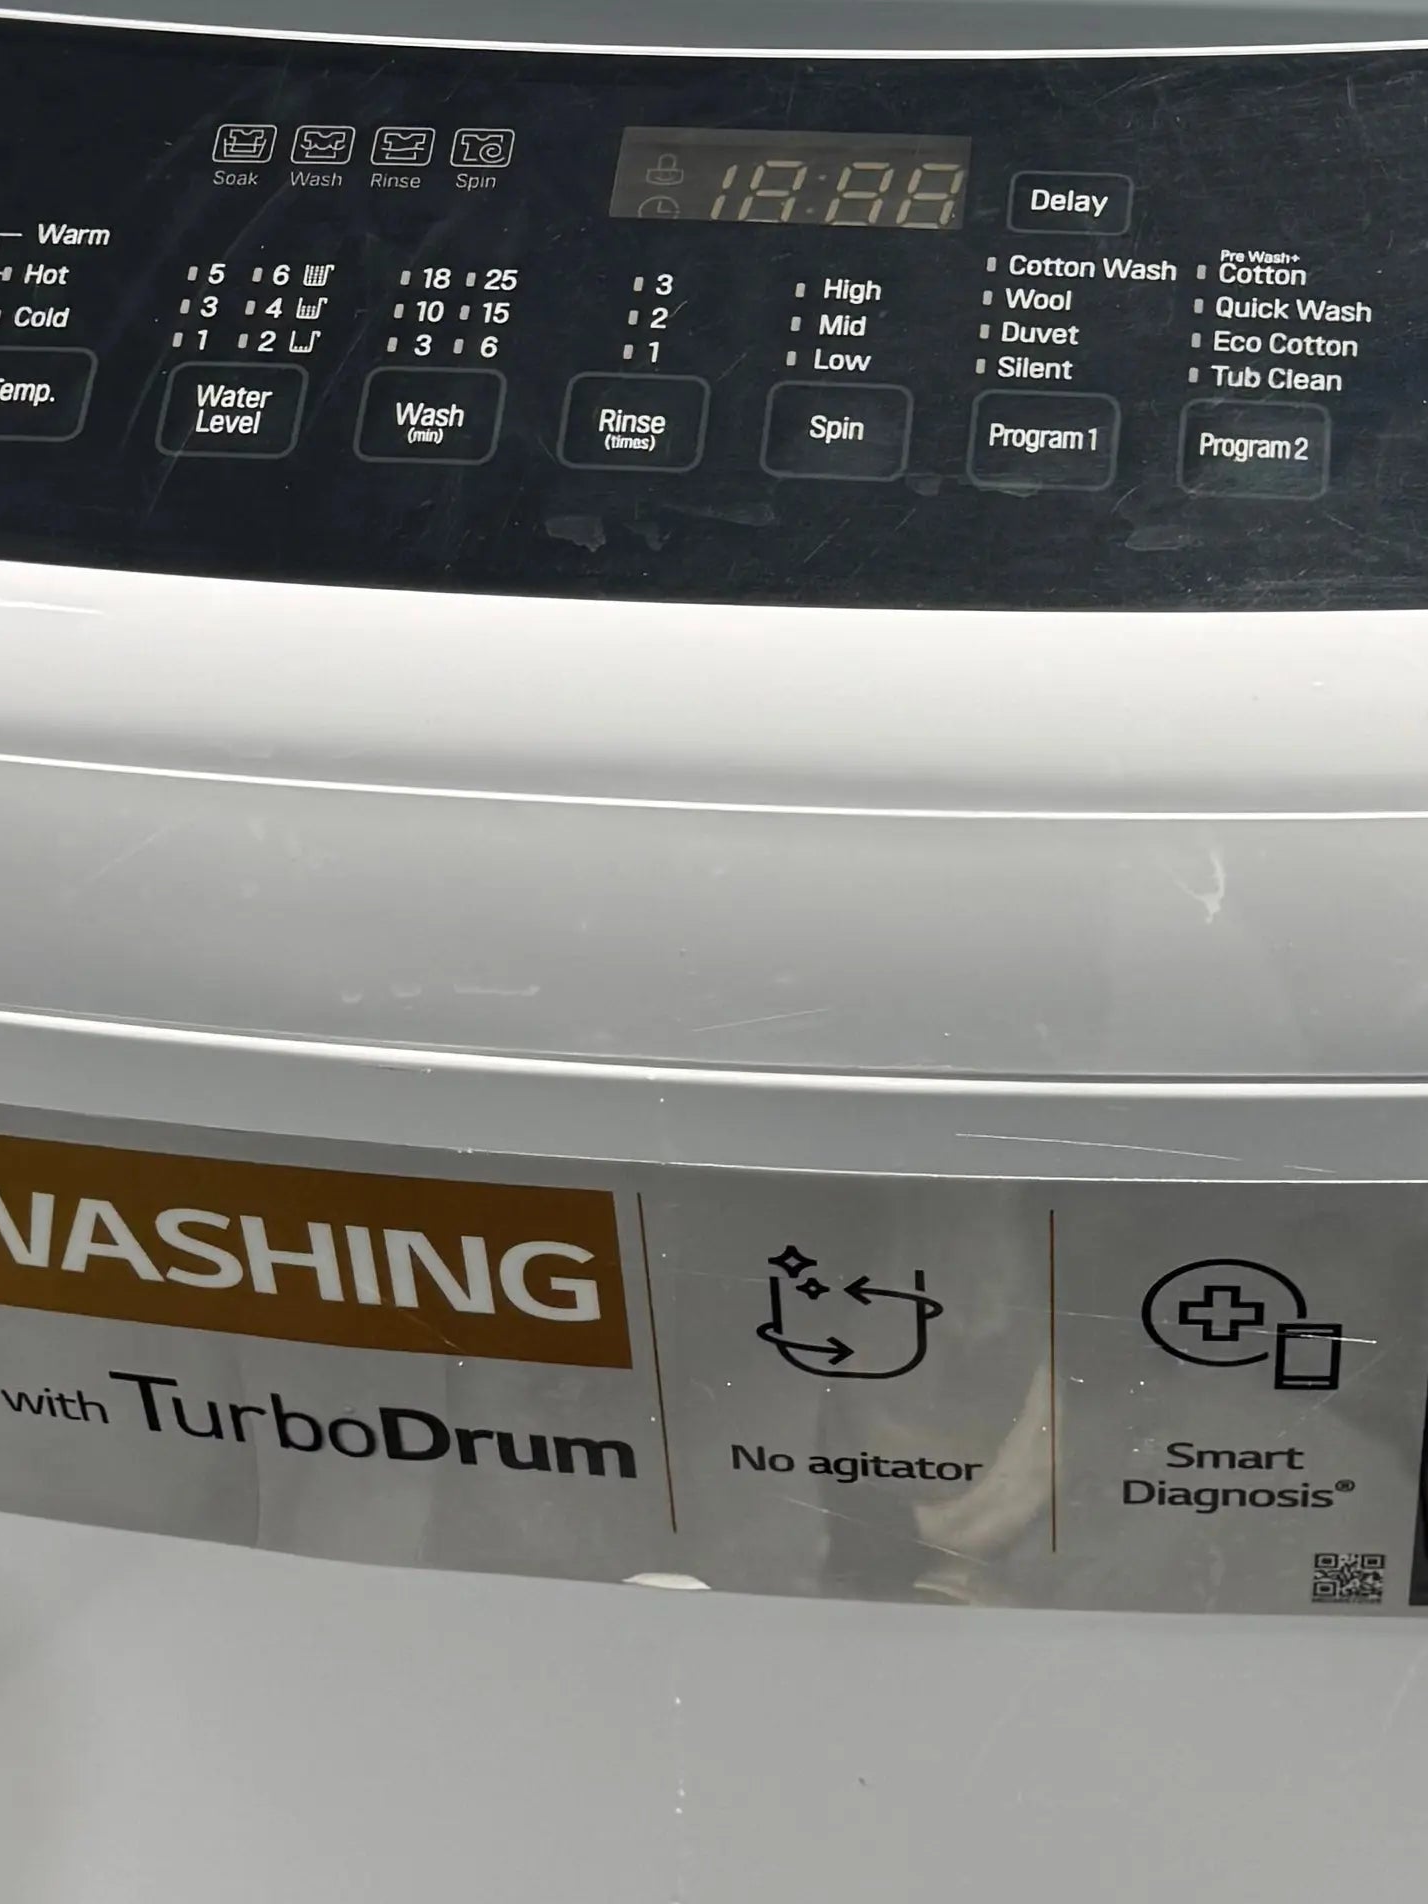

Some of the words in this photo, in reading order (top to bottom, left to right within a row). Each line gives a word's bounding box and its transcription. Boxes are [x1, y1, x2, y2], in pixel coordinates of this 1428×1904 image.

[213, 170, 260, 187] Soak
[289, 171, 343, 187] Wash
[370, 173, 421, 189] Rinse
[455, 174, 497, 191] Spin
[1030, 188, 1109, 218] Delay
[36, 223, 111, 246] Warm
[1008, 254, 1095, 279] Cotton
[1103, 257, 1177, 282] Wash
[1219, 249, 1245, 263] Pre
[22, 263, 70, 285] Hot
[207, 263, 226, 284] 5
[272, 264, 291, 285] 6
[423, 267, 452, 289] 18
[484, 269, 518, 291] 25
[655, 274, 674, 296] 3
[1218, 262, 1307, 287] Cotton
[823, 278, 882, 305] High
[1005, 287, 1073, 312] Wool
[13, 306, 70, 328] Cold
[200, 296, 218, 318] 3
[264, 297, 283, 318] 4
[416, 300, 445, 322] 10
[482, 302, 510, 324] 15
[649, 307, 669, 329] 2
[1215, 296, 1290, 320] Quick
[1295, 299, 1373, 324] Wash
[818, 314, 868, 338] Mid
[1001, 321, 1080, 346] Duvet
[196, 329, 209, 351] 1
[257, 331, 277, 352] 2
[413, 334, 433, 356] 3
[480, 335, 499, 358] 6
[648, 341, 661, 363] 1
[1212, 330, 1262, 354] Eco
[1268, 333, 1359, 358] Cotton
[813, 347, 872, 372] Low
[997, 355, 1073, 381] Silent
[1210, 364, 1262, 389] Tub
[1267, 367, 1343, 392] Clean
[196, 383, 273, 409] Water
[195, 409, 262, 434] Level
[395, 402, 465, 428] Wash
[598, 408, 666, 435] Rinse
[407, 427, 444, 445] (min)
[808, 414, 865, 444] Spin
[989, 422, 1084, 454] Program
[1087, 428, 1098, 451] 1
[604, 433, 656, 452] (times)
[1199, 432, 1291, 462] Program
[1294, 437, 1309, 461] 2
[0, 1387, 110, 1425] with
[108, 1368, 638, 1480] TurboDrum
[729, 1443, 796, 1474] No
[808, 1446, 984, 1486] agitator
[1165, 1441, 1306, 1471] Smart
